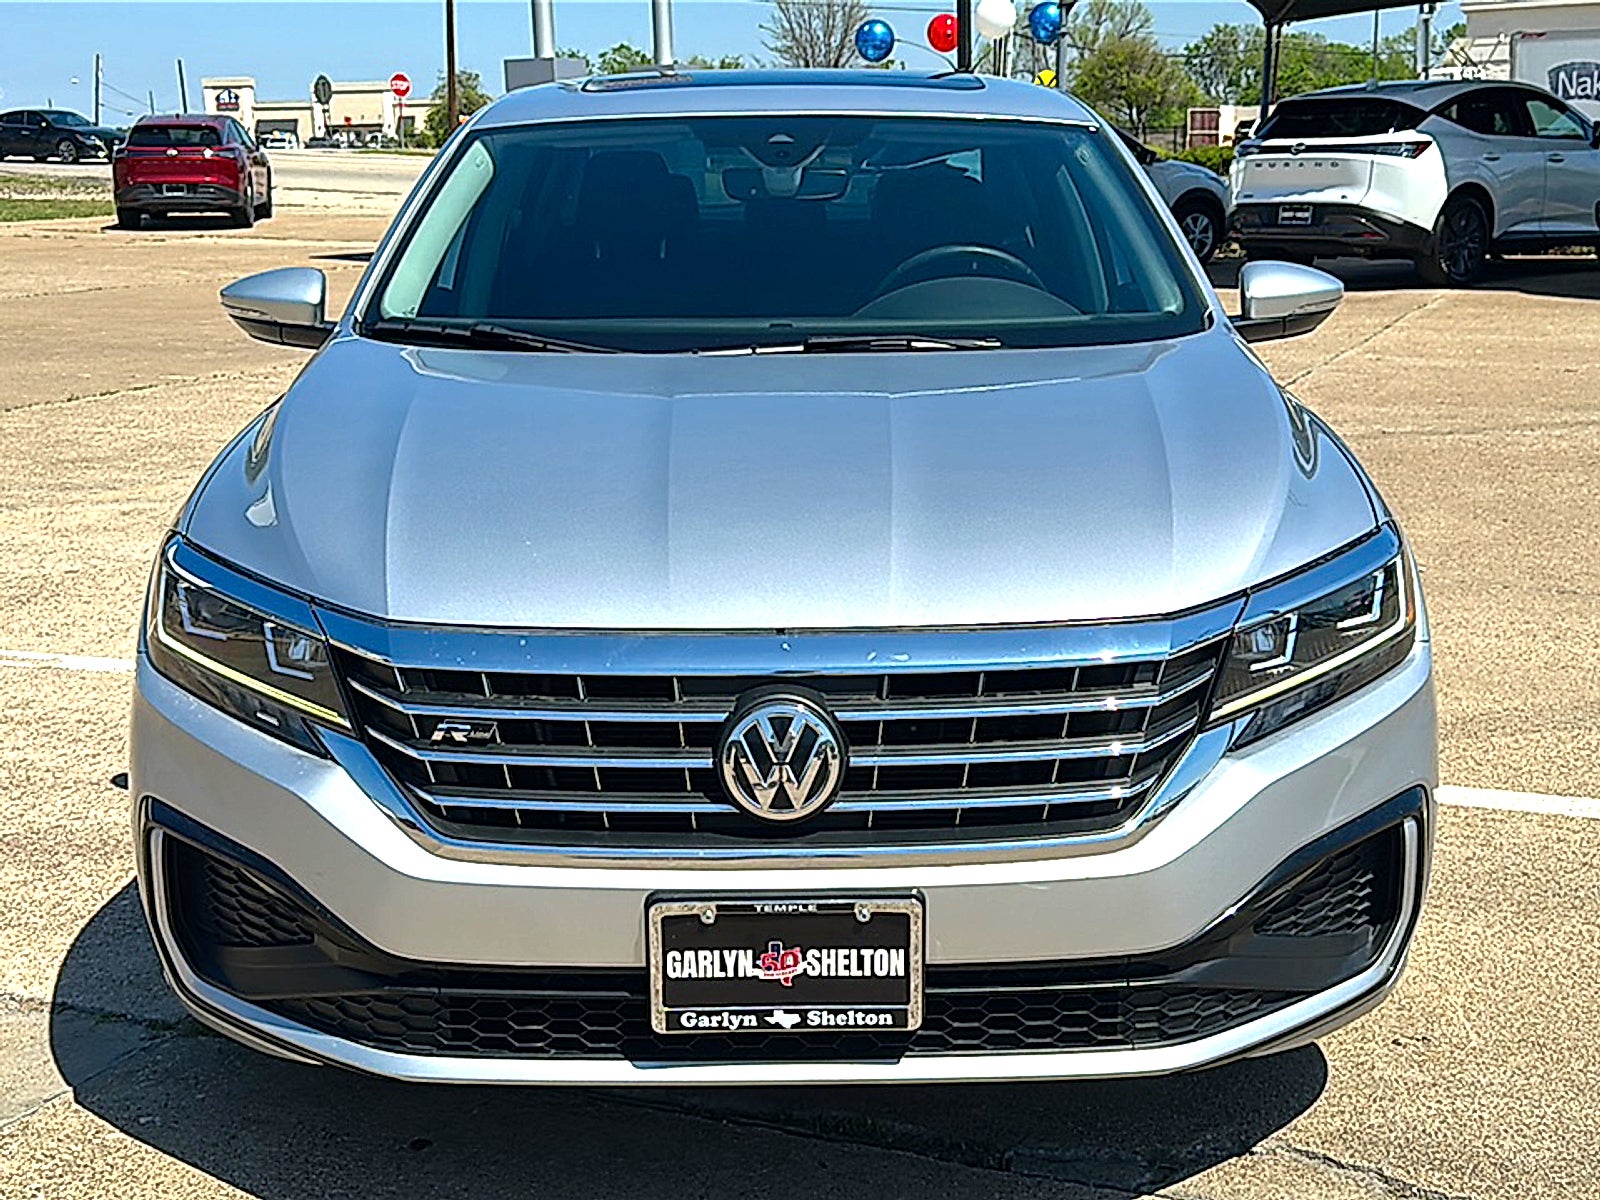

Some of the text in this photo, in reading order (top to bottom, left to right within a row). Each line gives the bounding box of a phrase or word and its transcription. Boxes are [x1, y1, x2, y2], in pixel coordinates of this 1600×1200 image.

[390, 80, 410, 91] STOP
[753, 903, 818, 913] TEMPLE
[666, 947, 905, 979] GARLYN 50 SHELTON
[680, 1010, 894, 1030] Garlyn Shelton
